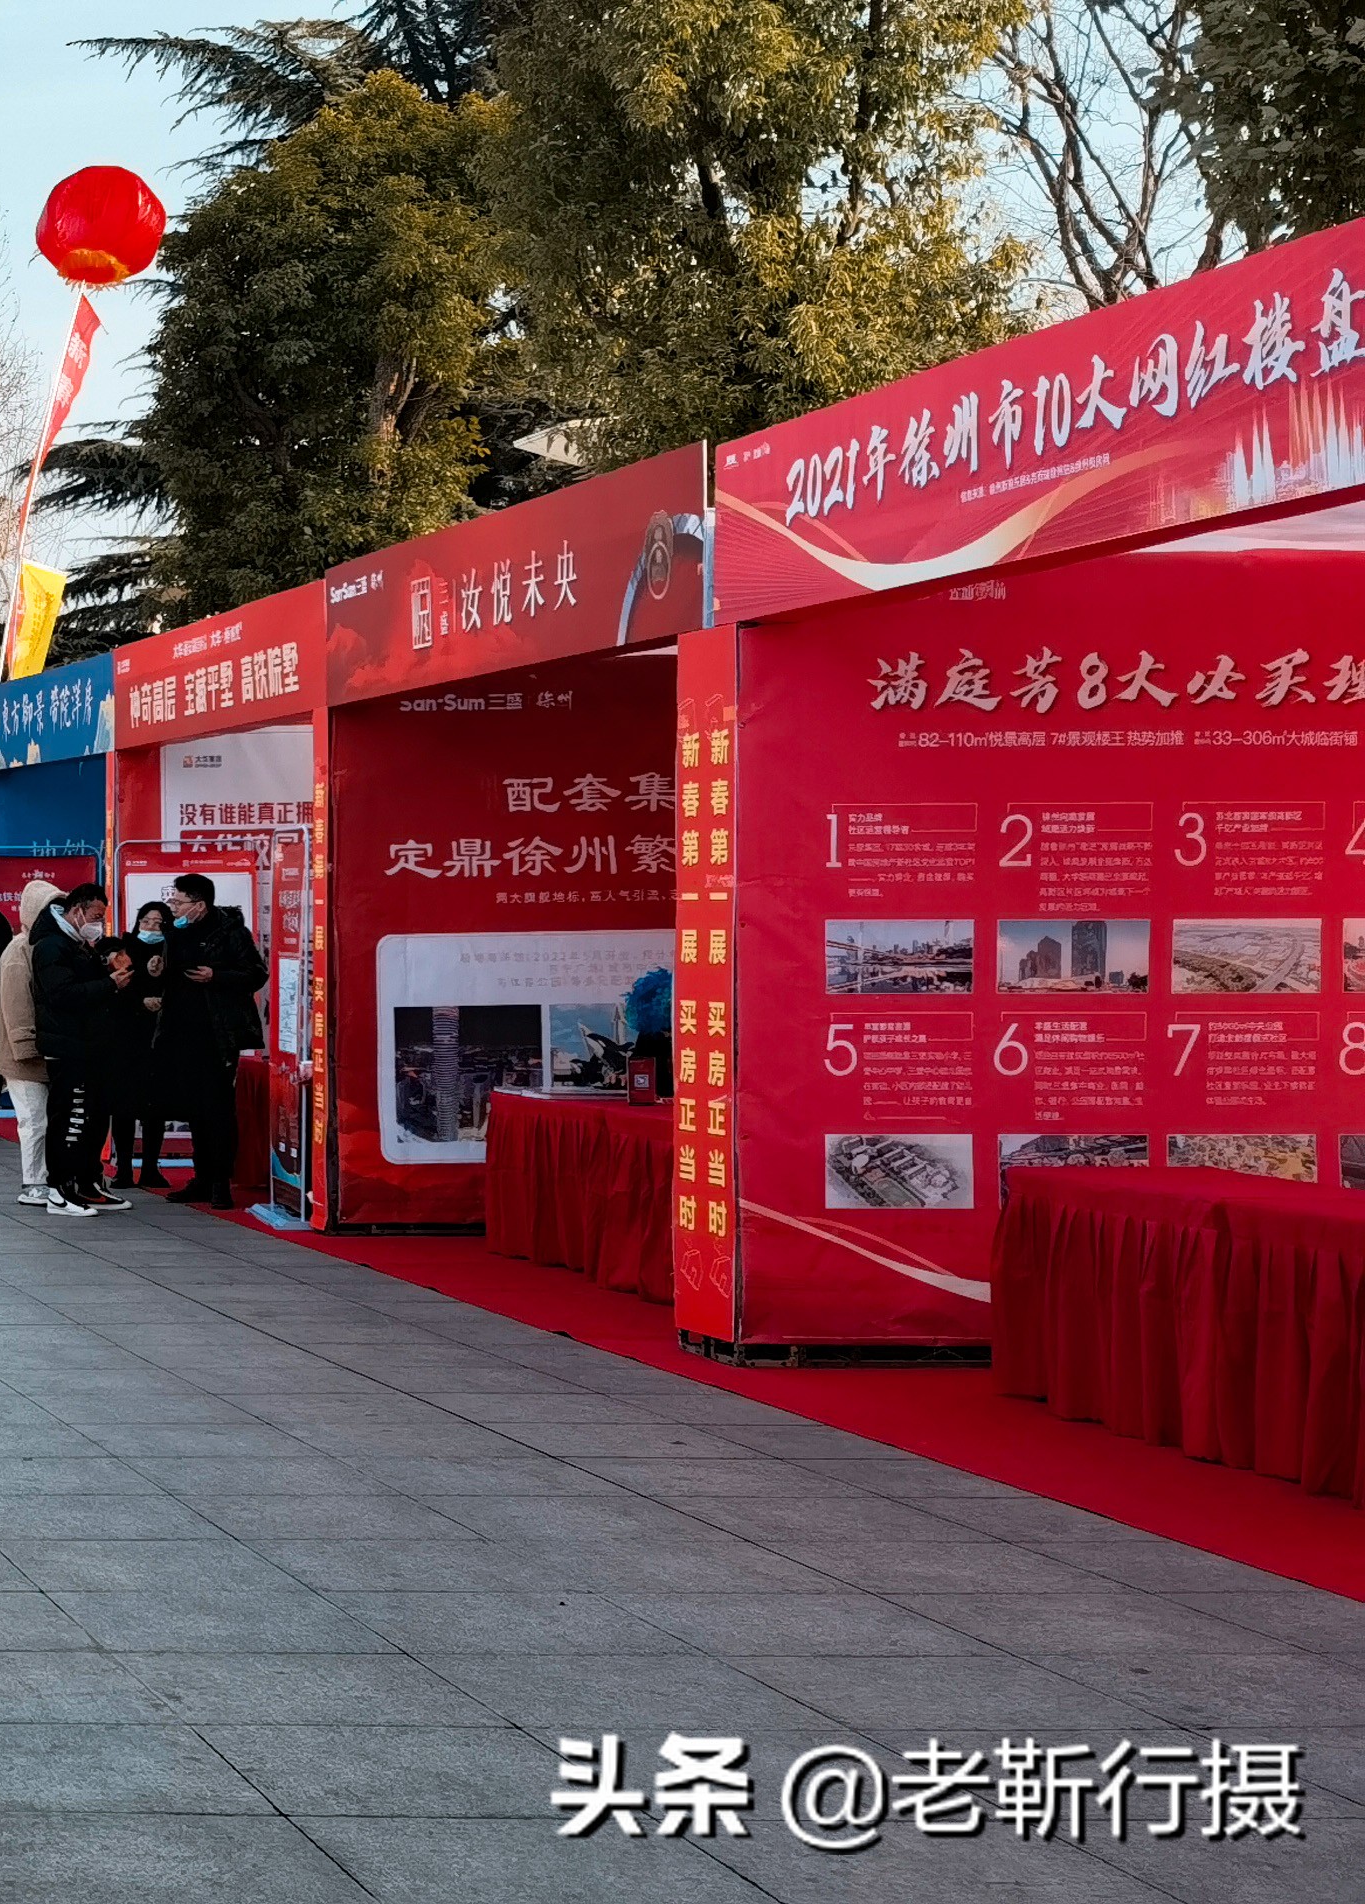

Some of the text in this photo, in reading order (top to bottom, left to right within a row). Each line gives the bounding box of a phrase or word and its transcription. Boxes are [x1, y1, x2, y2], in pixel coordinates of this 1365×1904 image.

[785, 268, 1365, 527] 2021年徐州市10大网红楼盘
[460, 538, 579, 635] 汝悦未央
[129, 641, 300, 729] 神奇高层 宝藏平墅 高铁院墅
[179, 801, 314, 826] 没有谁能真正拥
[502, 771, 676, 814] 配套集
[383, 834, 676, 879] 定鼎徐州繁
[825, 813, 843, 868] 1
[998, 813, 1033, 868] 2
[1173, 812, 1207, 867] 3
[824, 1023, 858, 1077] 5
[993, 1022, 1029, 1077] 6
[1167, 1023, 1201, 1077] 7
[1338, 1021, 1365, 1076] 8
